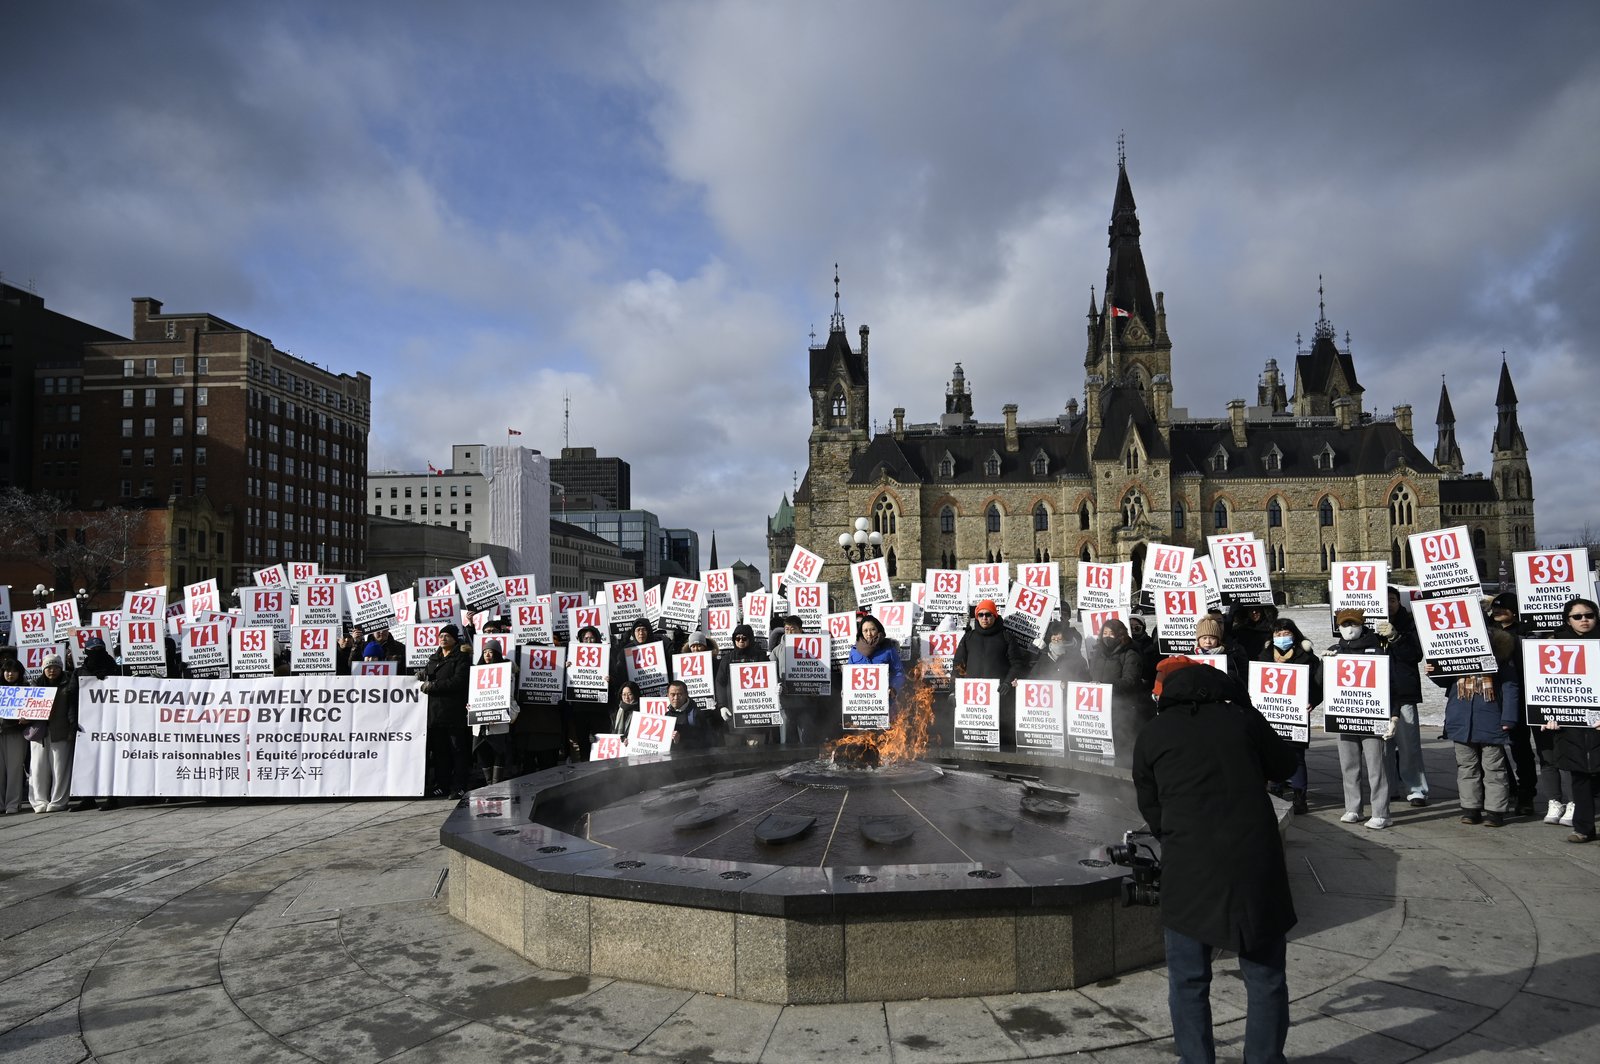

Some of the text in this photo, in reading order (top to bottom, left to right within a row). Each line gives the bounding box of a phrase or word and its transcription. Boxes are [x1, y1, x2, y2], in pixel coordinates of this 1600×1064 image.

[1226, 545, 1253, 568] 36
[1425, 534, 1456, 562] 90
[796, 553, 814, 576] 43
[1159, 549, 1181, 573] 70
[1430, 562, 1460, 571] MONTHS
[1533, 554, 1569, 583] 39
[262, 569, 280, 586] 25
[296, 565, 309, 580] 31
[463, 561, 486, 583] 33
[708, 572, 726, 592] 38
[860, 562, 880, 584] 29
[978, 567, 995, 585] 11
[1028, 566, 1047, 587] 27
[1089, 566, 1109, 589] 16
[1347, 566, 1371, 590] 37
[1423, 575, 1474, 588] IRCC RESPONSE
[1425, 568, 1469, 580] WAITING FOR
[358, 580, 380, 603] 68
[508, 578, 526, 596] 34
[675, 582, 697, 601] 34
[937, 573, 957, 592] 63
[1441, 587, 1469, 595] TIMELINES
[1535, 585, 1571, 594] MONTHS
[258, 592, 279, 611] 15
[310, 586, 331, 606] 53
[616, 583, 635, 603] 33
[645, 589, 657, 607] 30
[797, 586, 818, 607] 65
[1018, 590, 1042, 616] 35
[1168, 591, 1194, 614] 31
[1527, 593, 1581, 602] WAITING FOR
[53, 603, 72, 622] 39
[132, 595, 153, 615] 42
[431, 598, 452, 618] 55
[751, 596, 766, 616] 55
[23, 612, 43, 632] 32
[103, 613, 120, 631] 39
[521, 606, 541, 625] 34
[579, 608, 597, 627] 27
[710, 610, 728, 630] 30
[882, 606, 901, 625] 72
[1431, 601, 1467, 630] 31
[132, 623, 153, 643] 11
[193, 626, 215, 646] 71
[416, 627, 437, 646] 68
[830, 617, 848, 638] 62
[1436, 631, 1469, 640] MONTHS
[243, 630, 263, 651] 53
[303, 629, 325, 649] 34
[797, 637, 819, 659] 40
[934, 635, 954, 655] 23
[1430, 638, 1480, 648] WAITING FOR
[533, 649, 553, 670] 81
[579, 646, 600, 667] 33
[636, 646, 655, 667] 46
[1445, 645, 1486, 655] RESPONSE
[1544, 645, 1580, 674] 37
[683, 656, 702, 676] 24
[1341, 660, 1372, 687] 37
[1452, 663, 1480, 671] RESULTS
[480, 668, 499, 689] 41
[742, 666, 766, 689] 34
[854, 668, 876, 690] 35
[1264, 668, 1293, 694] 37
[1545, 677, 1582, 685] MONTHS
[24, 688, 46, 698] THE
[89, 688, 419, 706] WE DEMAND A TIMELY DECISION
[966, 682, 987, 705] 18
[1027, 684, 1051, 707] 36
[1078, 687, 1100, 711] 21
[1340, 690, 1372, 698] MONTHS
[1531, 694, 1599, 704] IRCC RESPONSE
[1536, 686, 1593, 694] WAITING FOR
[1256, 704, 1284, 712] WAITING
[1263, 697, 1292, 705] MONTHS
[1333, 697, 1381, 707] WAITING FOR
[1345, 706, 1385, 715] RESPONSE
[160, 707, 342, 723] DELAYED BY IRCC
[1267, 712, 1304, 721] RESPONSE
[91, 732, 241, 743] REASONABLE TIMELINES
[256, 731, 412, 743] PROCEDURAL FAIRNESS
[641, 717, 660, 740] 22
[122, 749, 241, 760] Délais raisonnables
[256, 748, 378, 762] Équité procédurale
[599, 738, 618, 759] 43
[176, 766, 240, 780] 给出时限
[257, 766, 324, 780] 程序公平
